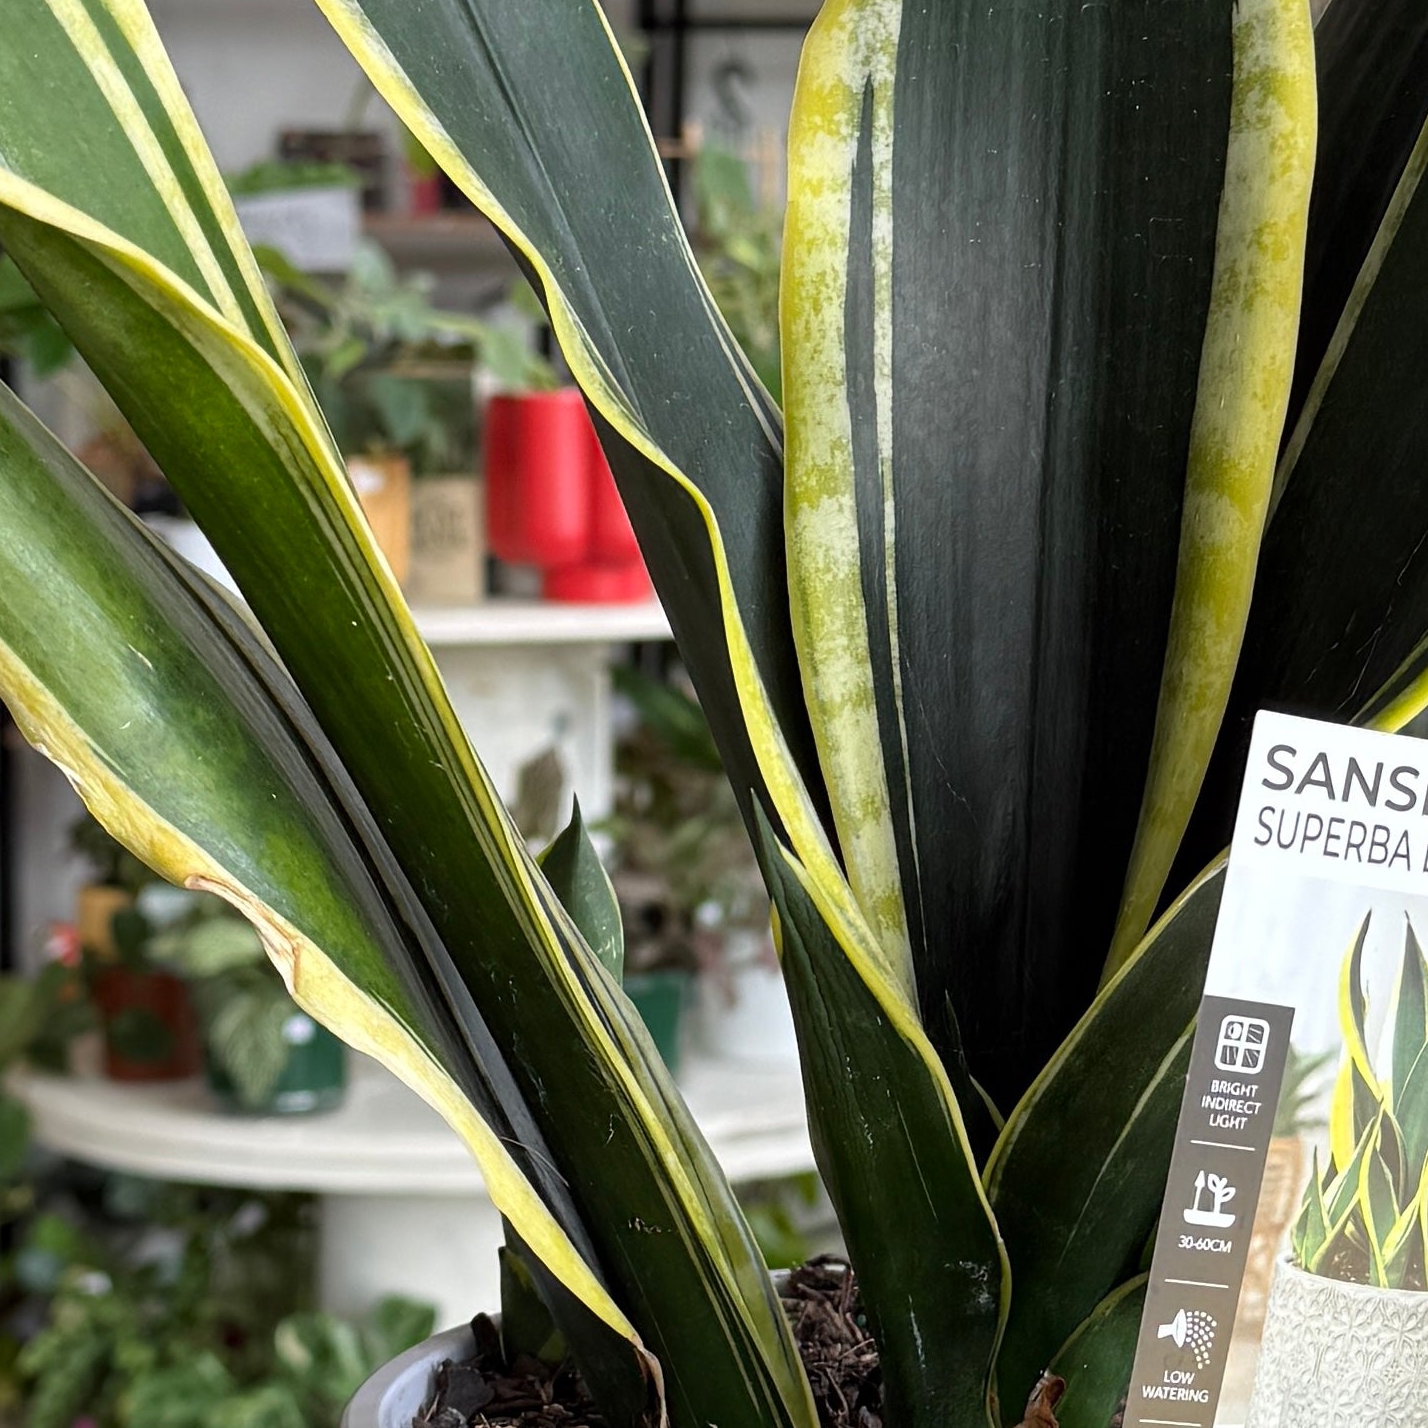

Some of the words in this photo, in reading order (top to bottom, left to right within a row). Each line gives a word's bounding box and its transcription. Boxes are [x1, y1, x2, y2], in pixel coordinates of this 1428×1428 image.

[1254, 805, 1412, 871] SUPERBA
[1211, 1079, 1258, 1098] BRIGHT
[1201, 1095, 1262, 1115] INDIRECT
[1209, 1113, 1248, 1130] LIGHT
[1178, 1234, 1232, 1253] 30-60CM
[1163, 1370, 1195, 1385] LOW
[1142, 1385, 1209, 1403] WATERING
